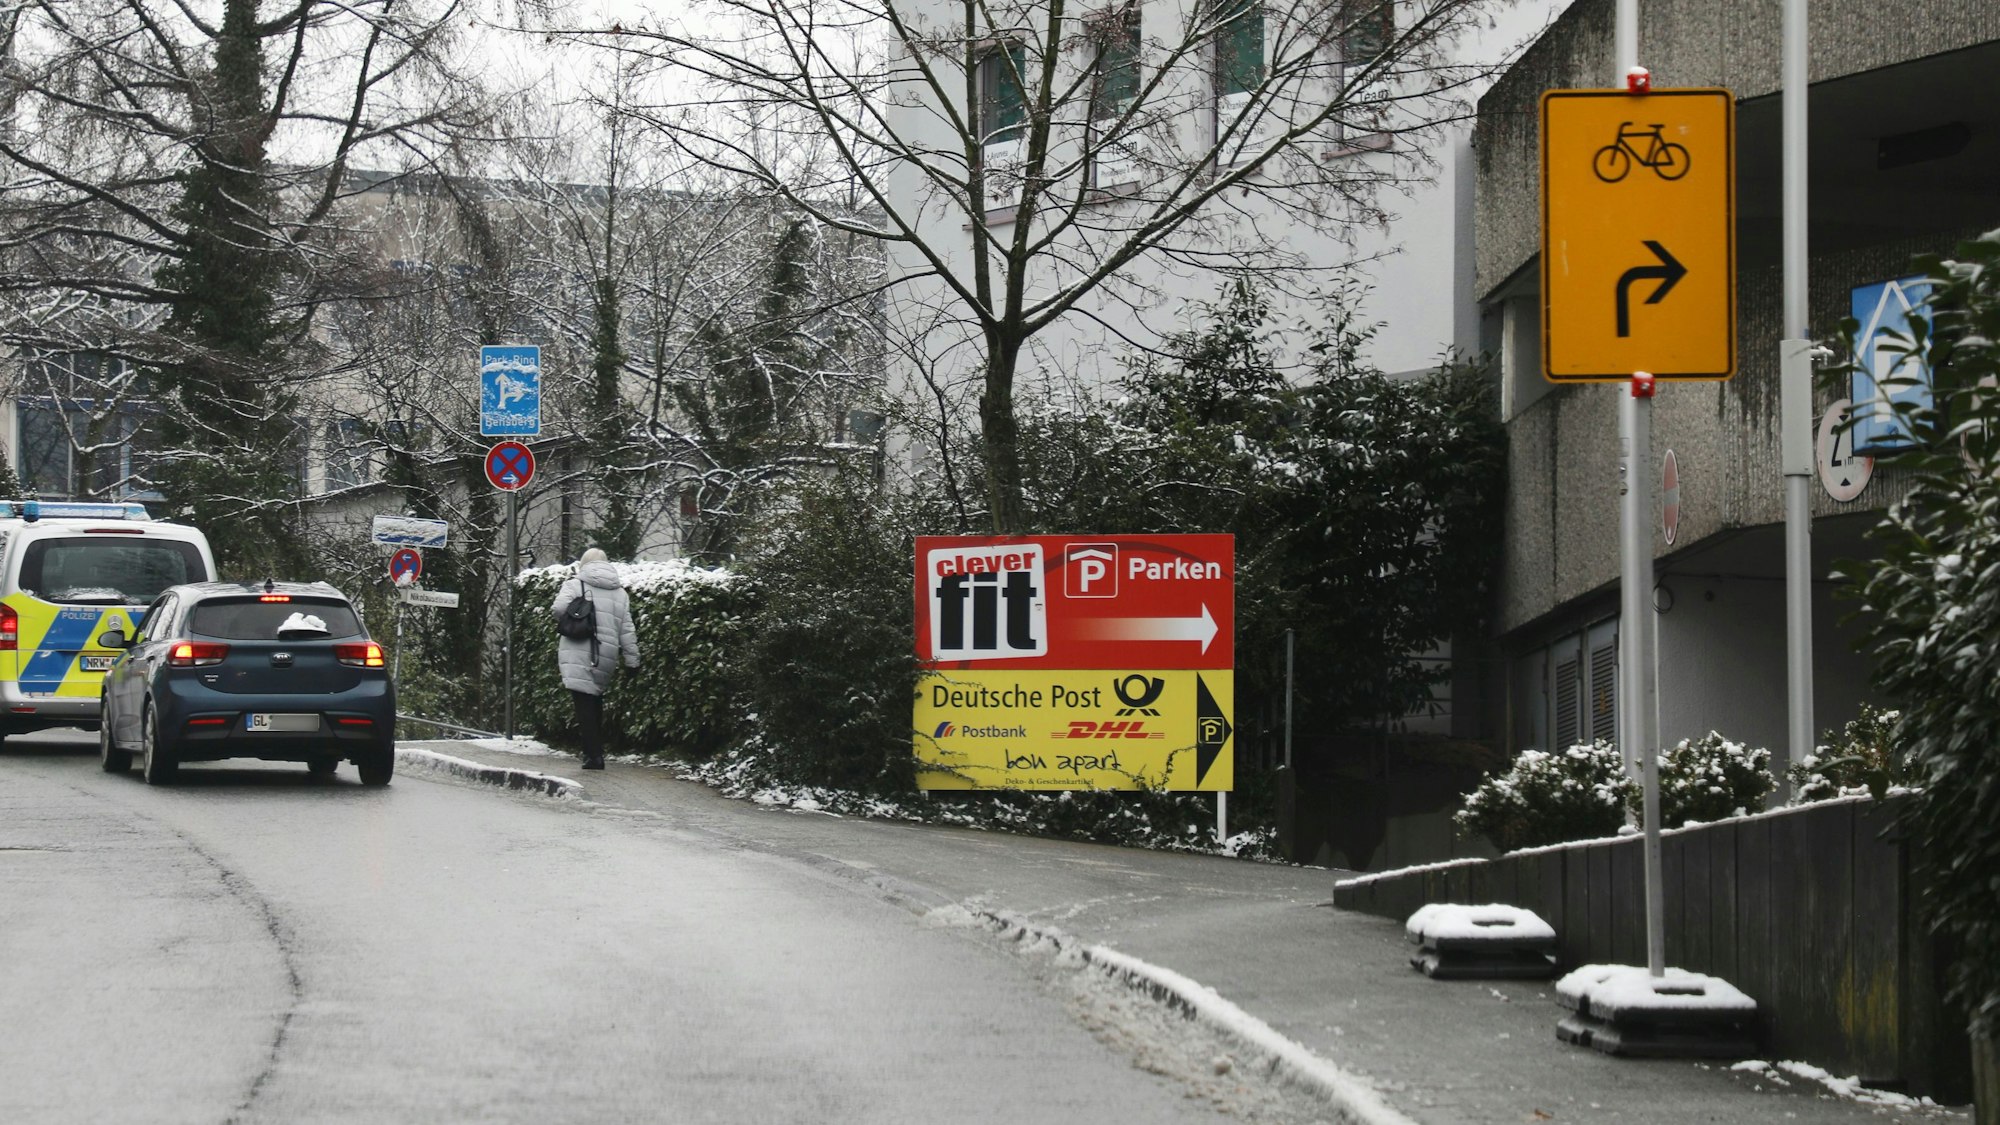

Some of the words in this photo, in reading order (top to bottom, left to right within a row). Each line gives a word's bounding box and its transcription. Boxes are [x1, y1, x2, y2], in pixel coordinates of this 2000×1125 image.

[936, 552, 1036, 578] clever
[1081, 560, 1105, 592] P
[1129, 557, 1221, 580] Parken
[61, 611, 96, 620] POLIZEI
[936, 571, 1037, 650] fit
[86, 657, 105, 668] NRW
[933, 685, 1042, 708] Deutsche
[1052, 685, 1101, 708] Post
[253, 715, 268, 727] GL
[962, 725, 1027, 738] Postbank
[1066, 721, 1151, 739] DHL
[1205, 725, 1217, 741] P
[1005, 748, 1047, 769] bon
[1056, 749, 1122, 776] apart
[1005, 777, 1027, 785] Deko-
[1036, 777, 1094, 785] Geschenkartikel
